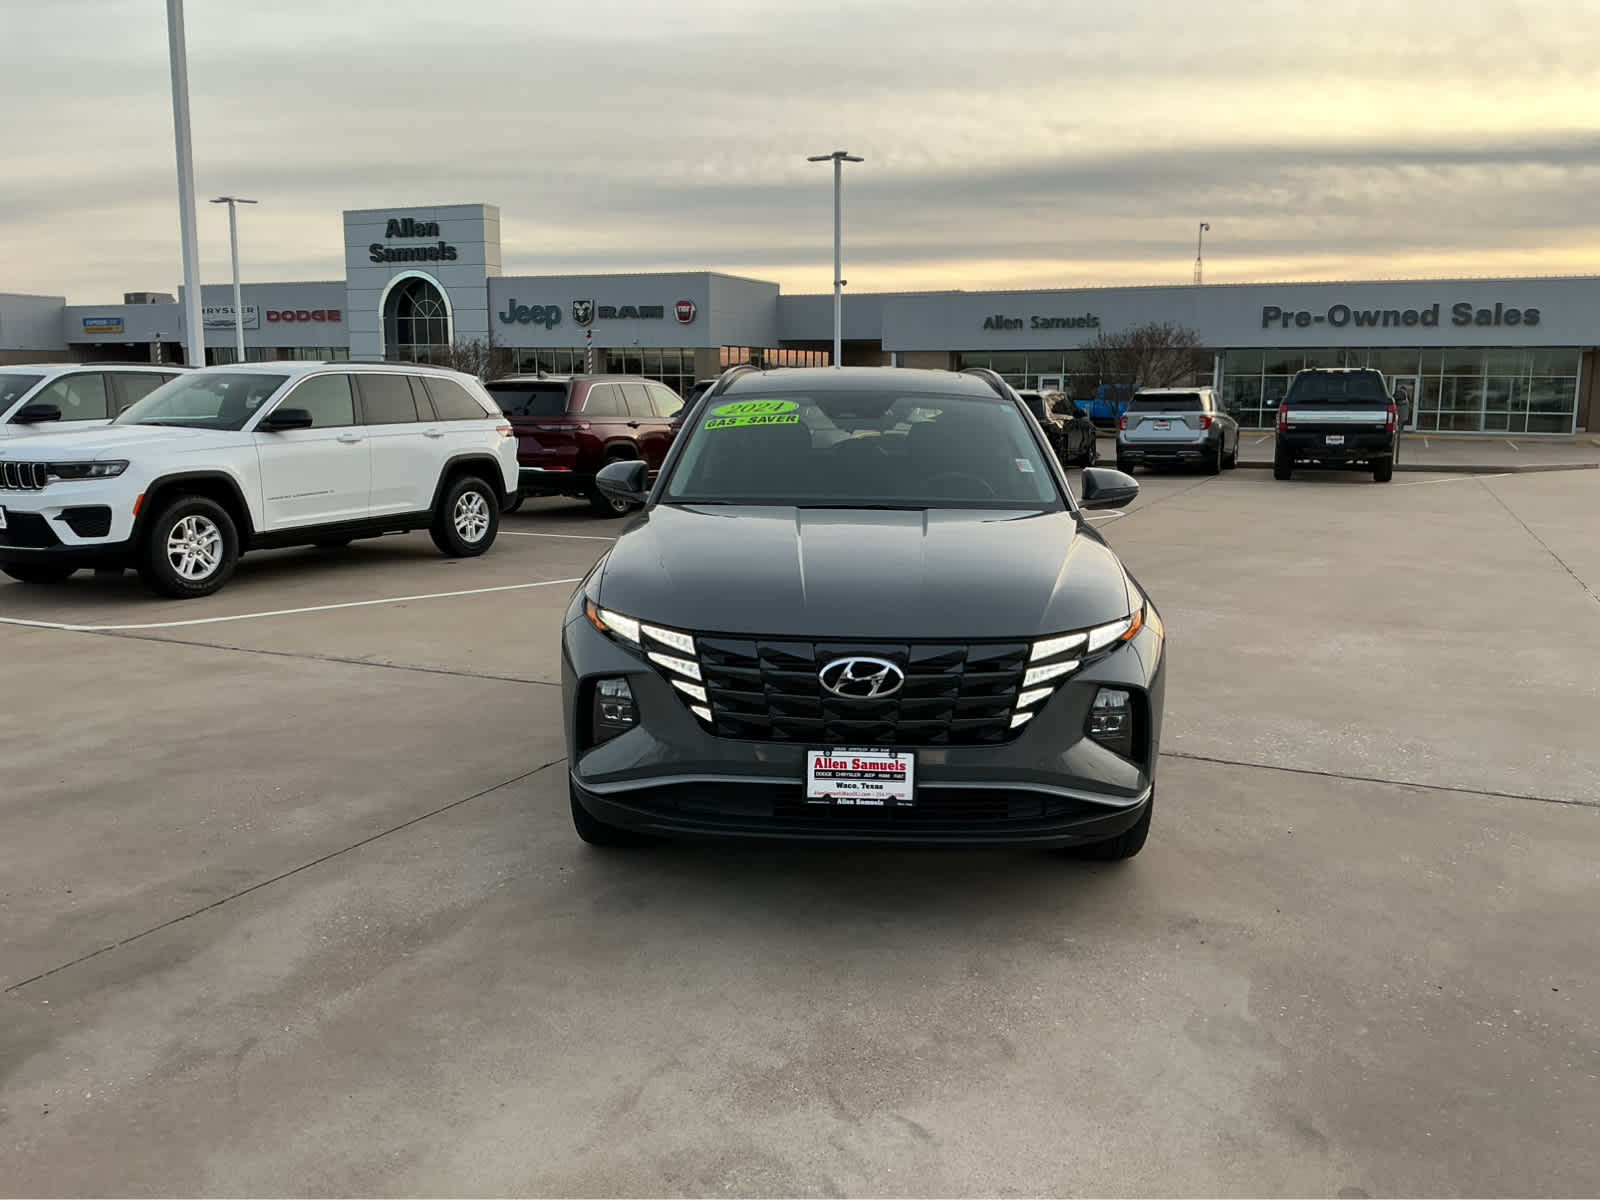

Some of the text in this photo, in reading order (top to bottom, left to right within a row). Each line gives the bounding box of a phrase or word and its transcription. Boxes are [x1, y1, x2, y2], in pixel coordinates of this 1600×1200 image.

[385, 217, 440, 238] Allen
[369, 241, 457, 263] Samuels
[201, 306, 254, 315] RYSLR
[266, 309, 342, 322] DODGE
[499, 298, 562, 330] Jeep
[598, 305, 664, 319] RAM
[1261, 302, 1541, 329] Pre-Owned Sales
[983, 313, 1100, 330] Allen Samuels
[727, 401, 786, 415] 2024
[707, 418, 737, 428] GAS
[747, 415, 797, 424] SAVER
[814, 757, 906, 771] Allen Samuels
[861, 782, 884, 790] Texas
